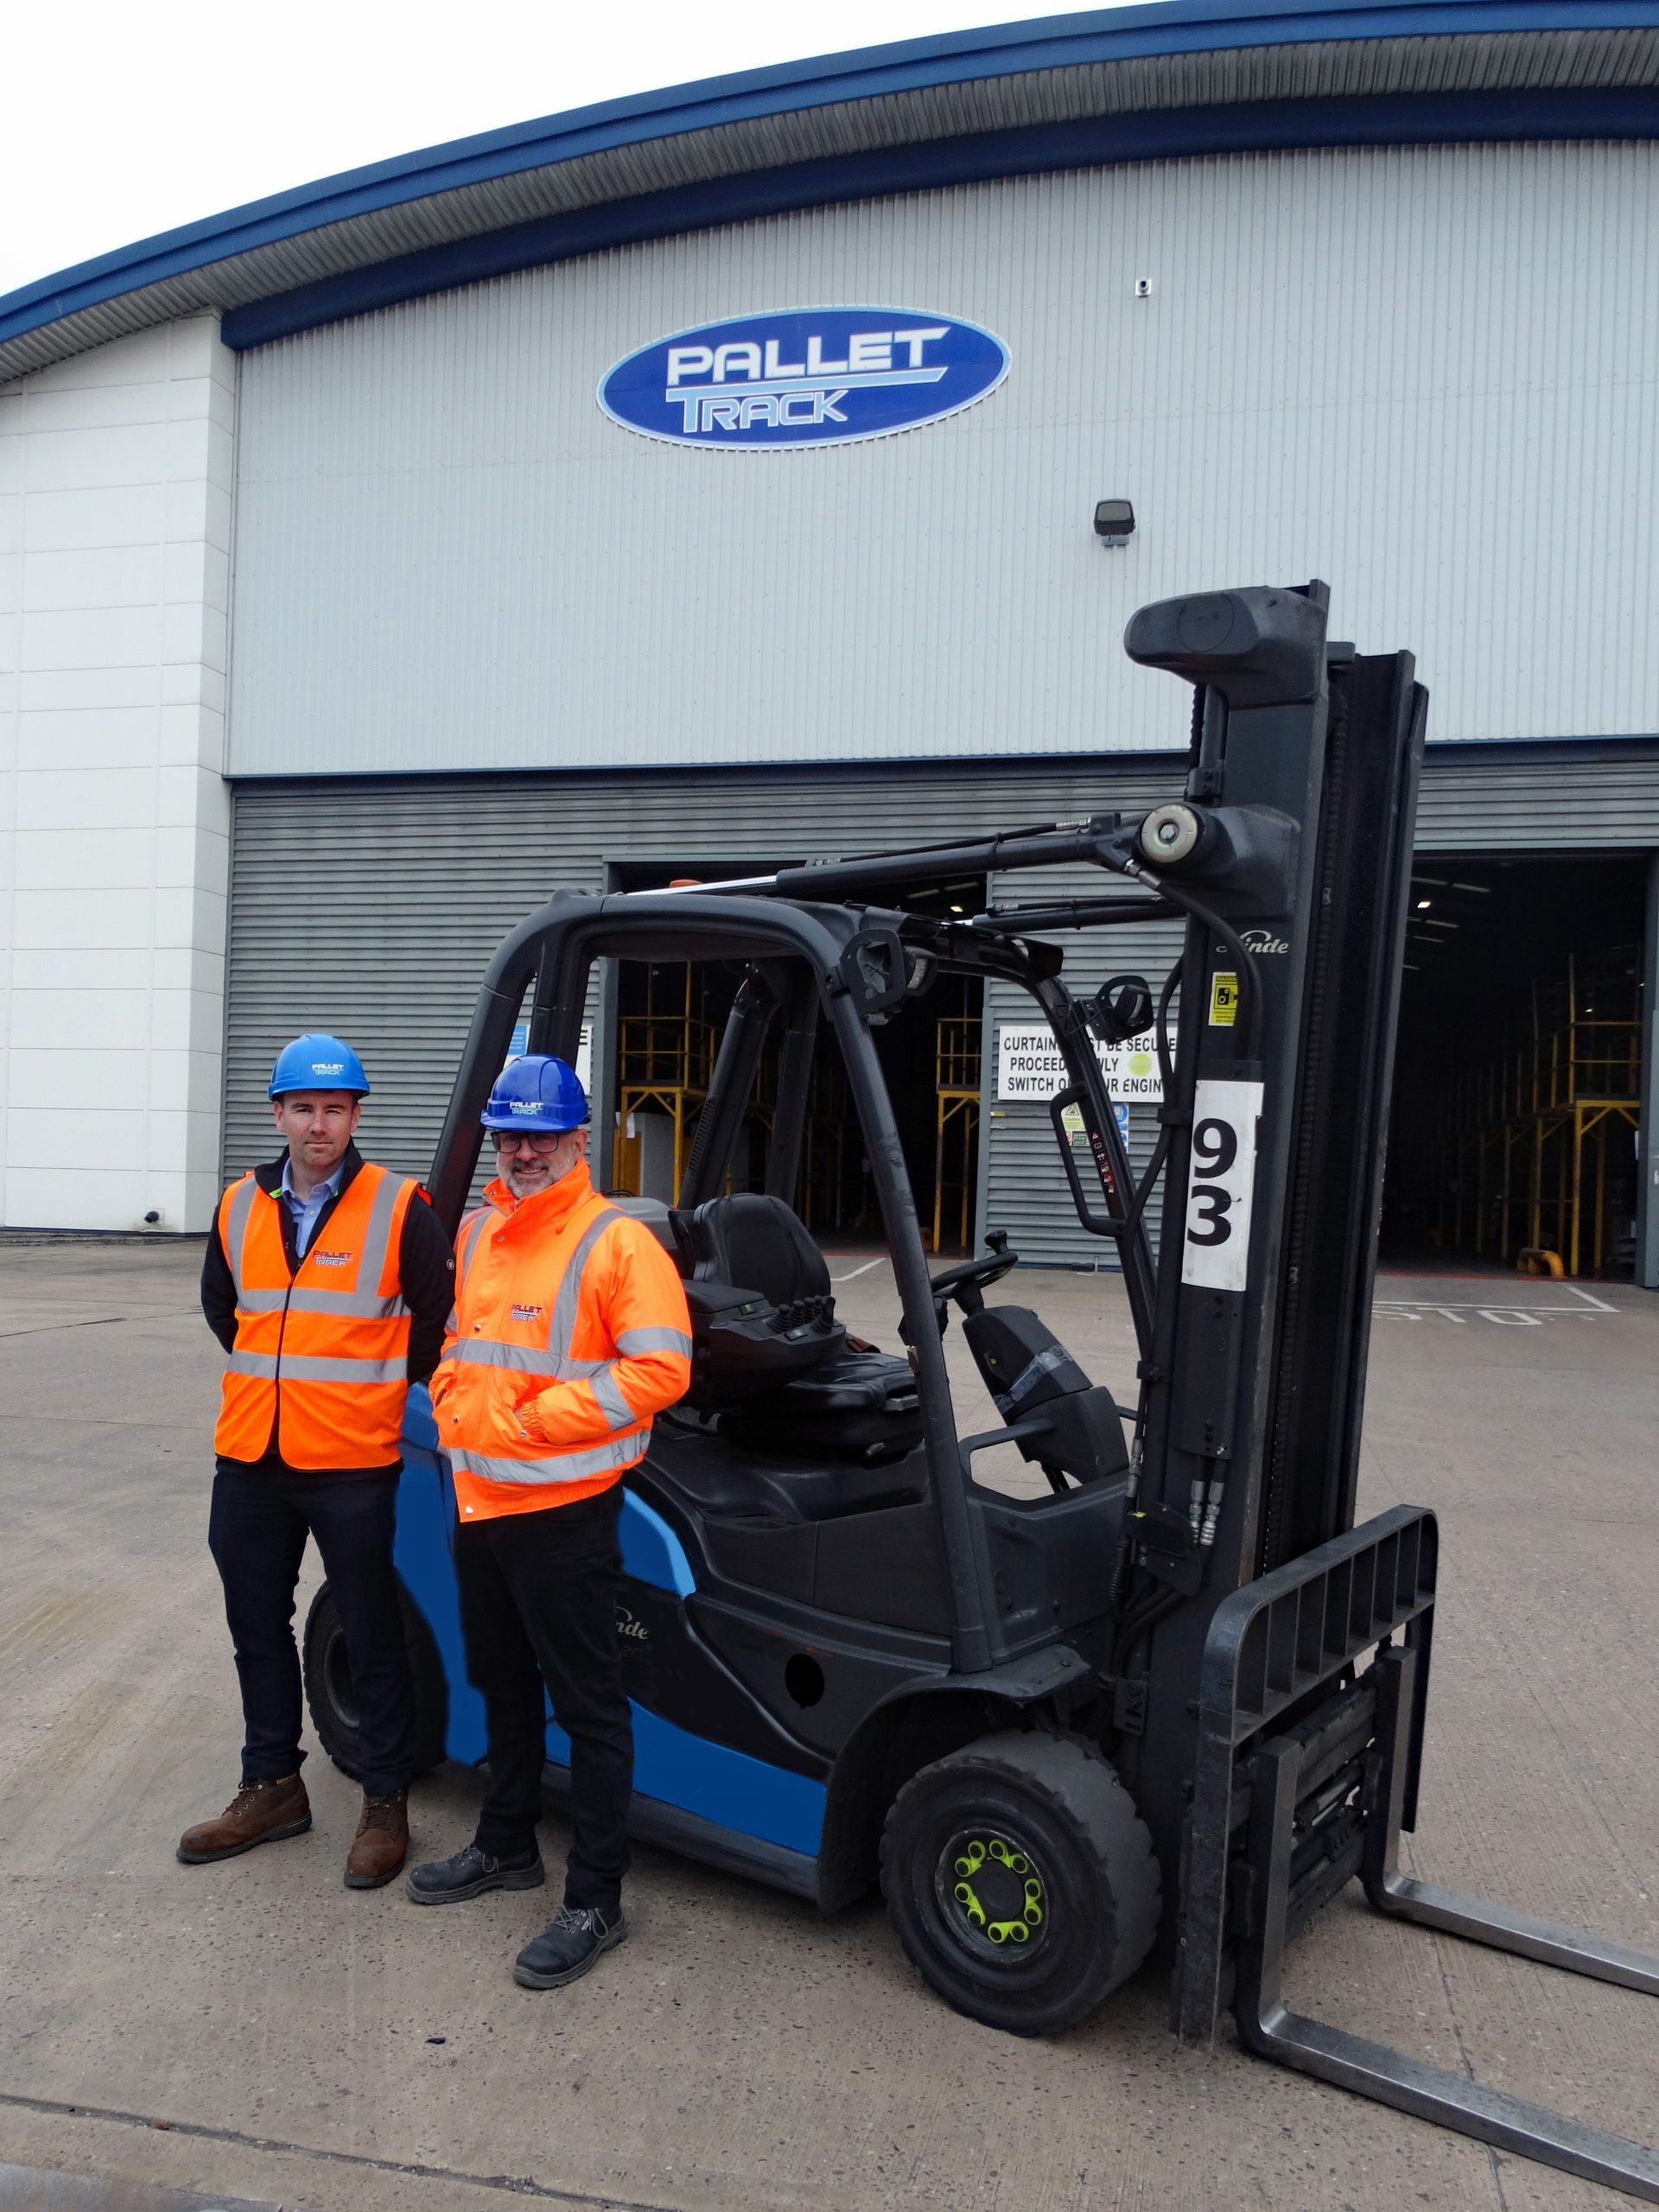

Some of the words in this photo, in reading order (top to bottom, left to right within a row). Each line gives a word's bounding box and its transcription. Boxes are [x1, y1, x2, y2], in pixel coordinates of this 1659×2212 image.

[667, 326, 951, 387] PALLET
[665, 387, 849, 434] TRACK
[1004, 1037, 1060, 1052] CURTAIN
[1010, 1057, 1066, 1071] PROCEED
[1007, 1077, 1054, 1091] SWITCH
[1122, 1078, 1162, 1093] ENGIN
[313, 1250, 353, 1259] PALLET
[511, 1304, 543, 1313] PALLET
